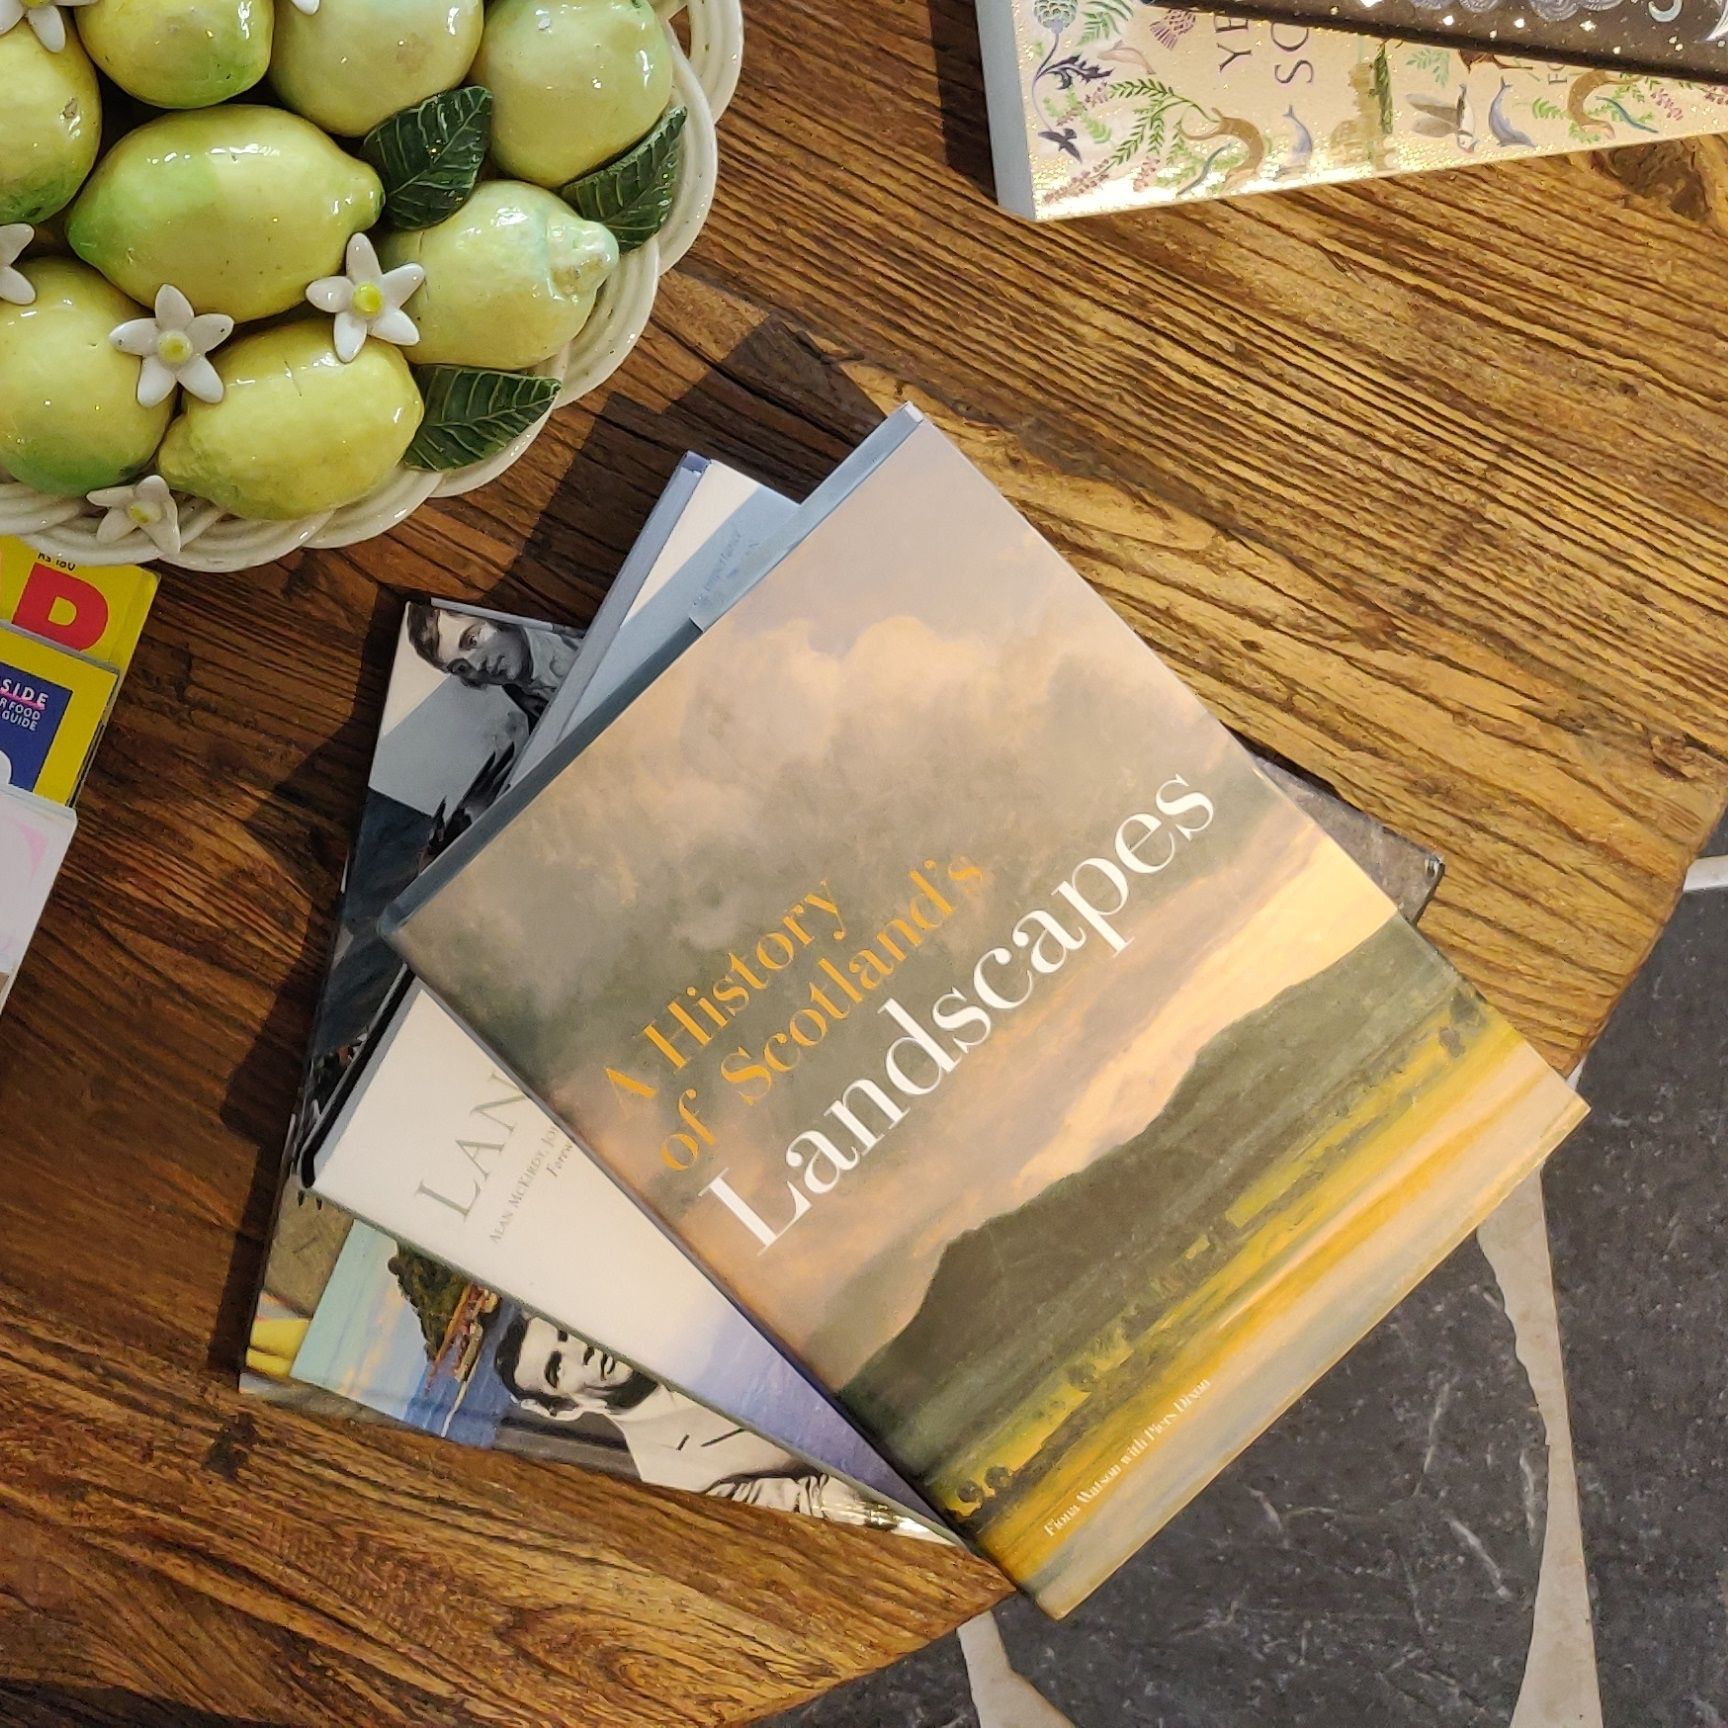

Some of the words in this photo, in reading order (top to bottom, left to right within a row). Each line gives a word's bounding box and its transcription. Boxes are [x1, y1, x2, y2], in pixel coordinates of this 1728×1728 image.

[0, 710, 37, 731] GUIDE
[7, 701, 41, 720] FOOD
[605, 1065, 658, 1112] A
[640, 875, 841, 1073] History
[658, 1086, 718, 1170] of
[717, 845, 989, 1107] Scotland's
[696, 767, 1218, 1256] Landscapes
[1043, 1502, 1080, 1537] Fiona
[1074, 1462, 1122, 1506] Watson
[1116, 1434, 1148, 1465] with
[1143, 1407, 1178, 1441] Piers
[1172, 1375, 1212, 1413] Dixon
